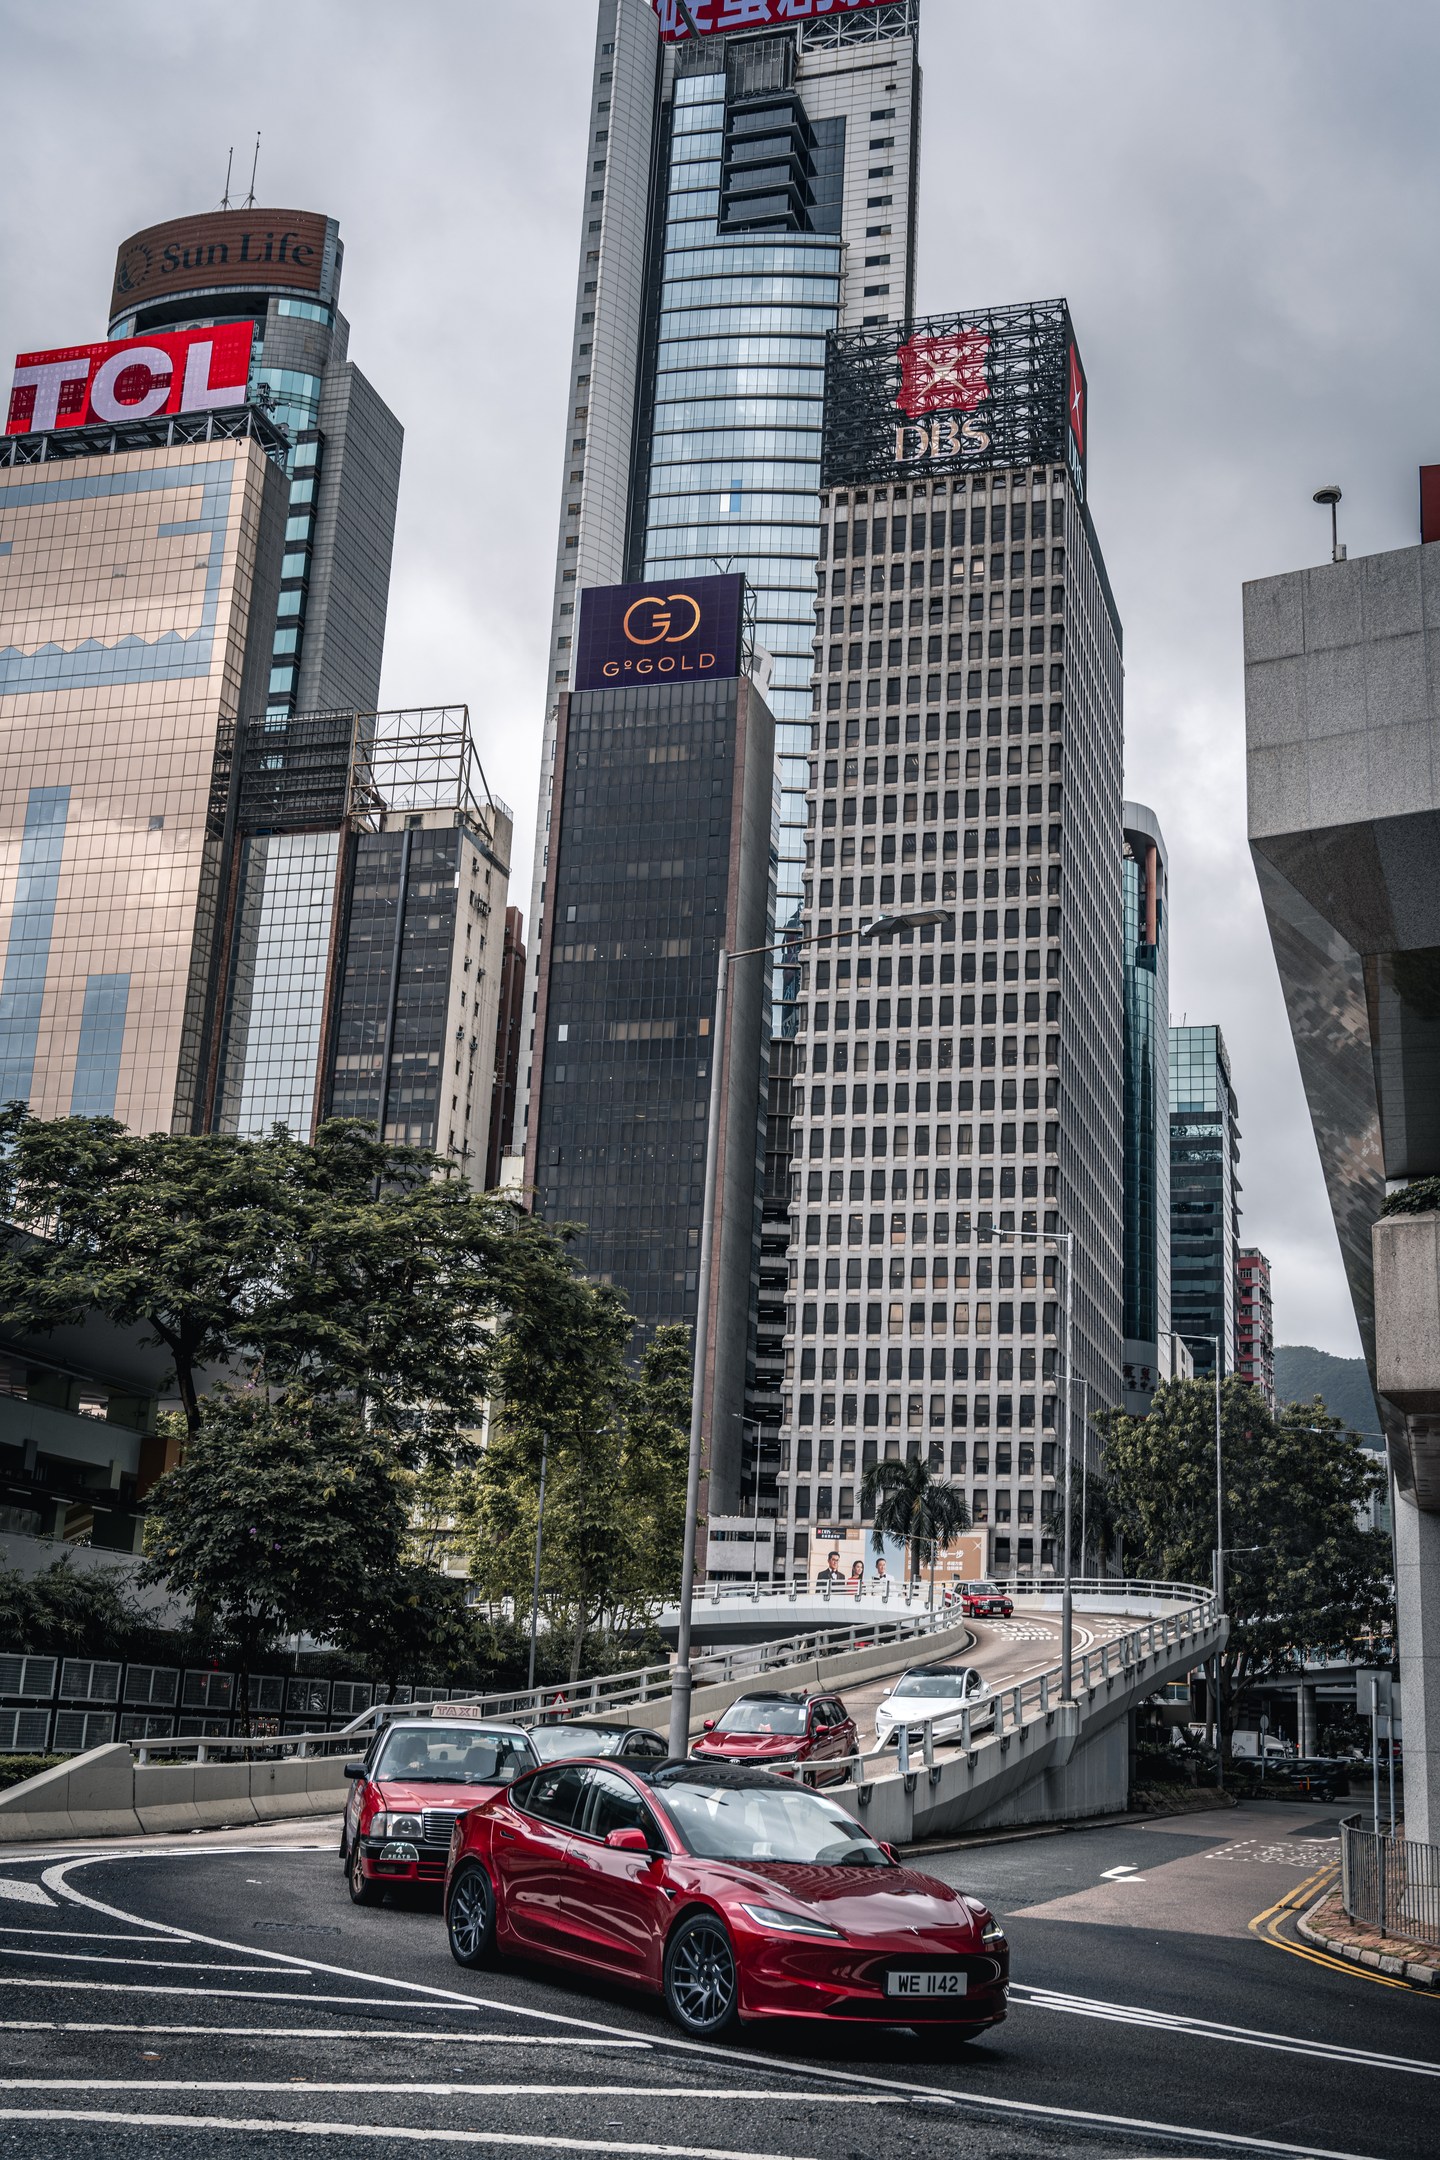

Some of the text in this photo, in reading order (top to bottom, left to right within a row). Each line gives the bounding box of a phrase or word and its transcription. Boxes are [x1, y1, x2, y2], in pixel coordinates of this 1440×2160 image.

[161, 232, 314, 274] Sun Life
[12, 340, 246, 431] TCL
[894, 417, 990, 463] DBS
[437, 1706, 478, 1717] TAXI
[395, 1846, 404, 1854] 4
[898, 1975, 958, 1993] WE 1142
